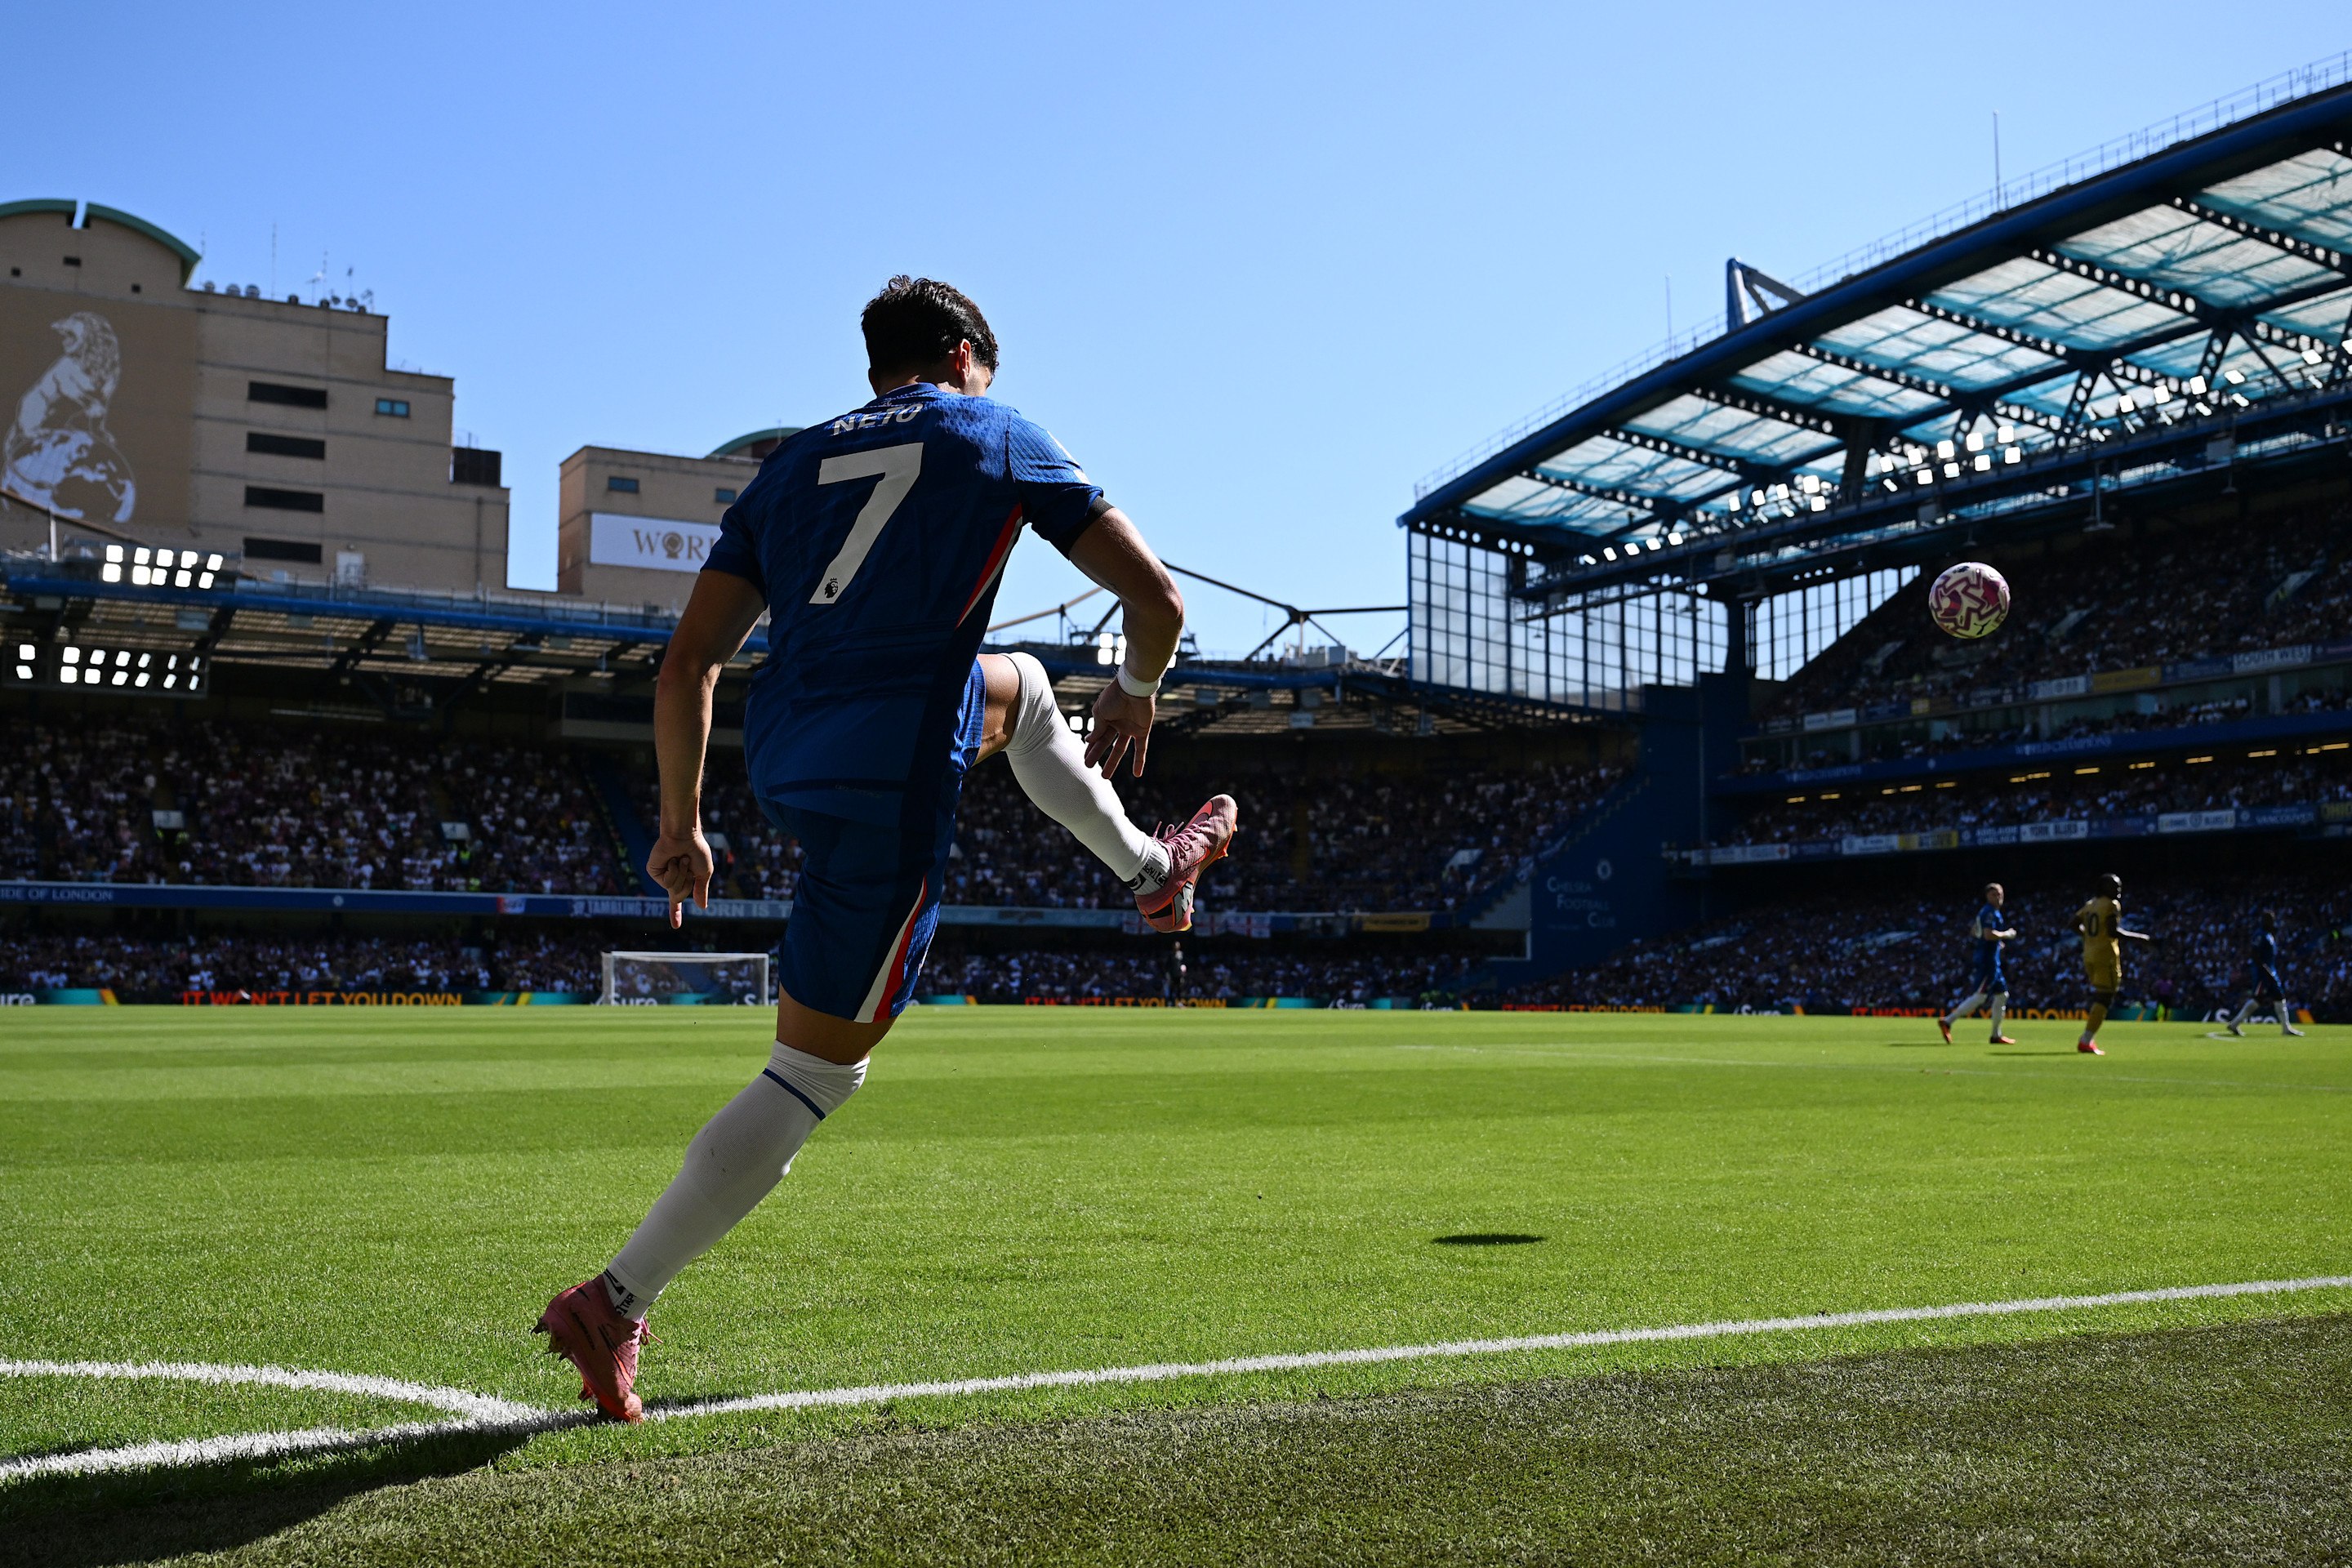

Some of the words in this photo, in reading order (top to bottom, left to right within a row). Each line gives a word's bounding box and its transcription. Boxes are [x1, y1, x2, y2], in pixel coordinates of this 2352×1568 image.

[831, 403, 923, 436] NETO
[808, 442, 924, 604] 7
[28, 888, 47, 902] OF
[52, 889, 114, 902] LONDON
[183, 991, 204, 1005] IT
[210, 991, 290, 1005] WN'T
[341, 992, 385, 1005] YOU
[391, 992, 462, 1006] DOWN
[2215, 1008, 2278, 1023] Sre
